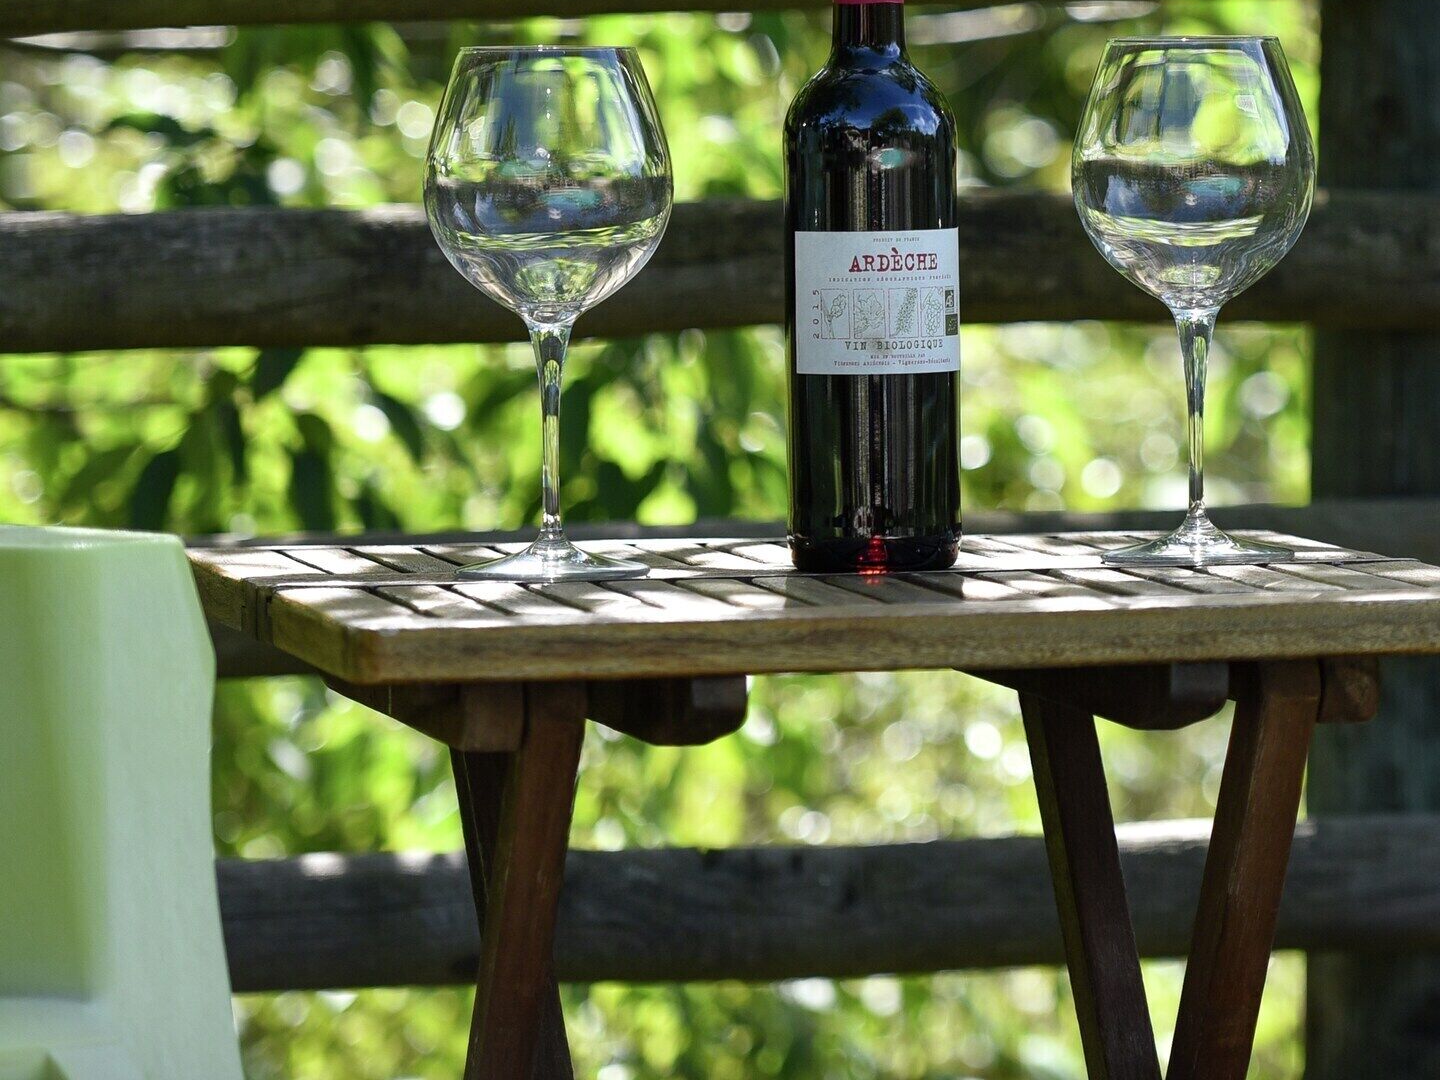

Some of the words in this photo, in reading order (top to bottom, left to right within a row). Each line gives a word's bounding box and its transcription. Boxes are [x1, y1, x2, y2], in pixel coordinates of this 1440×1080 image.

[848, 246, 938, 273] ARDÈCHE
[812, 289, 820, 339] 2015
[845, 341, 867, 351] VIN
[876, 339, 944, 351] BIOLOGIQUE
